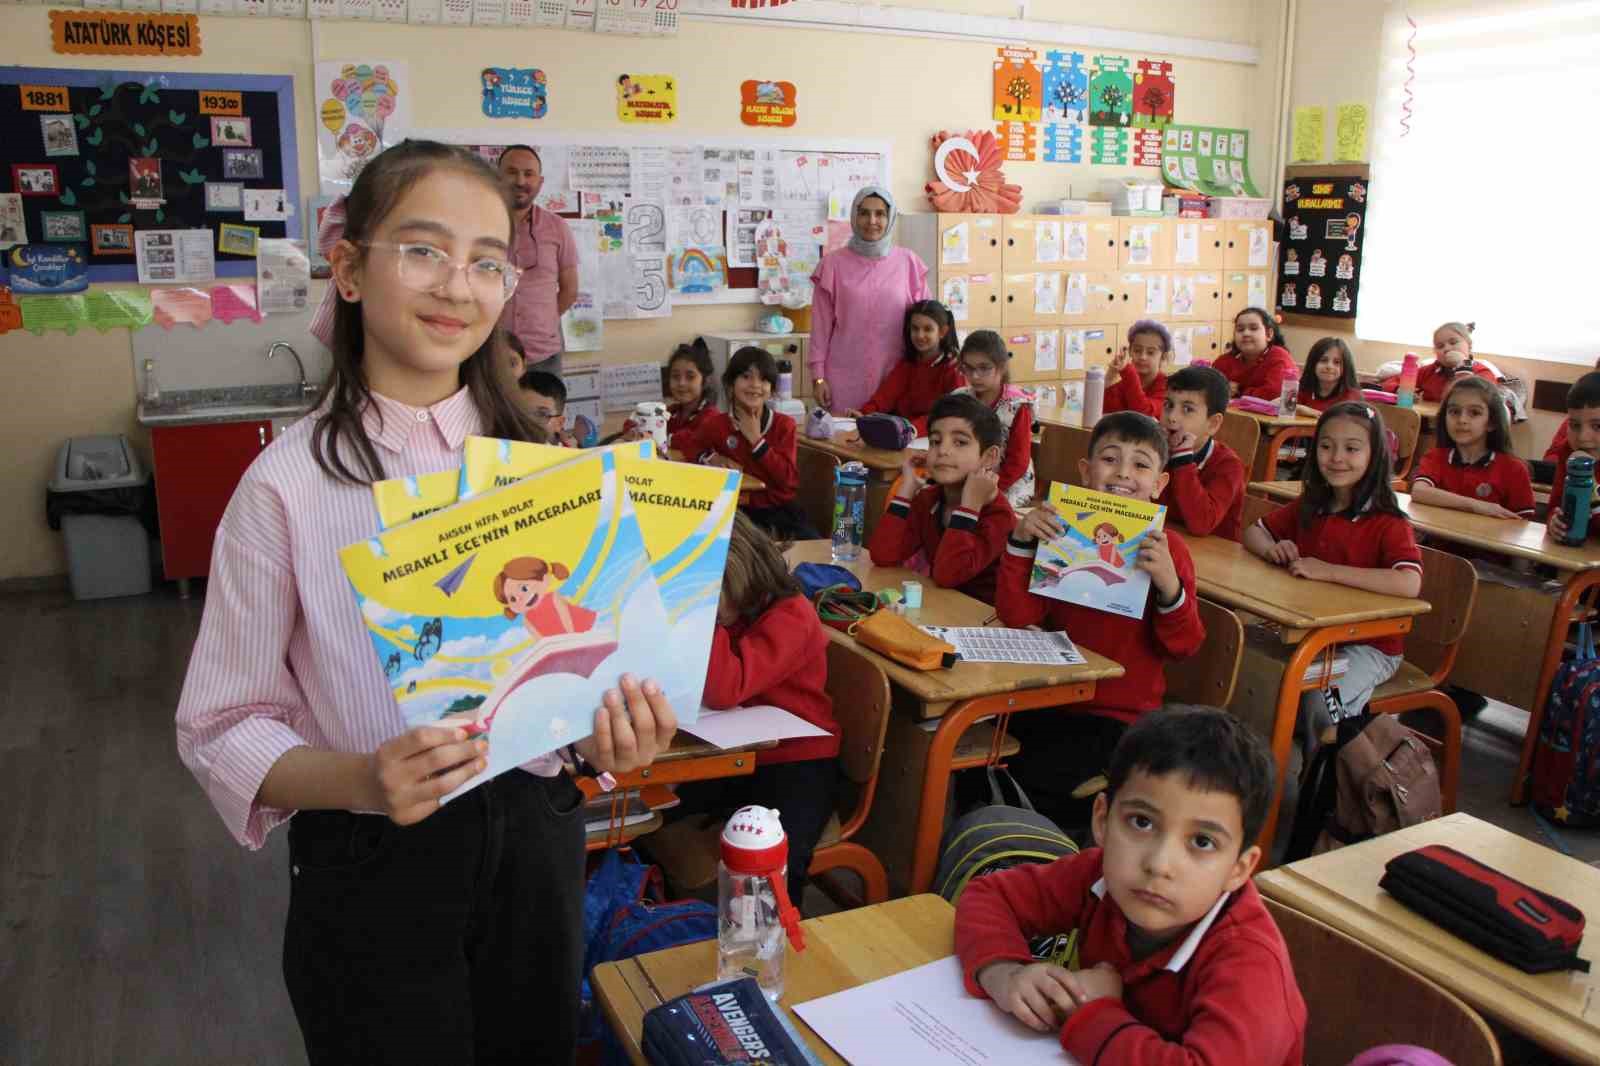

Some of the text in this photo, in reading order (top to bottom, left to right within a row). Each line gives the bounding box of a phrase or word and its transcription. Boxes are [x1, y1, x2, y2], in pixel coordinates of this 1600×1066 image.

[63, 19, 191, 52] ATATÜRK KÖŞESİ
[26, 91, 64, 107] 1881
[502, 499, 534, 519] BOLAT
[383, 548, 449, 583] MERAKLI
[514, 488, 602, 532] MACERALARI
[712, 992, 770, 1059] AVENGERS
